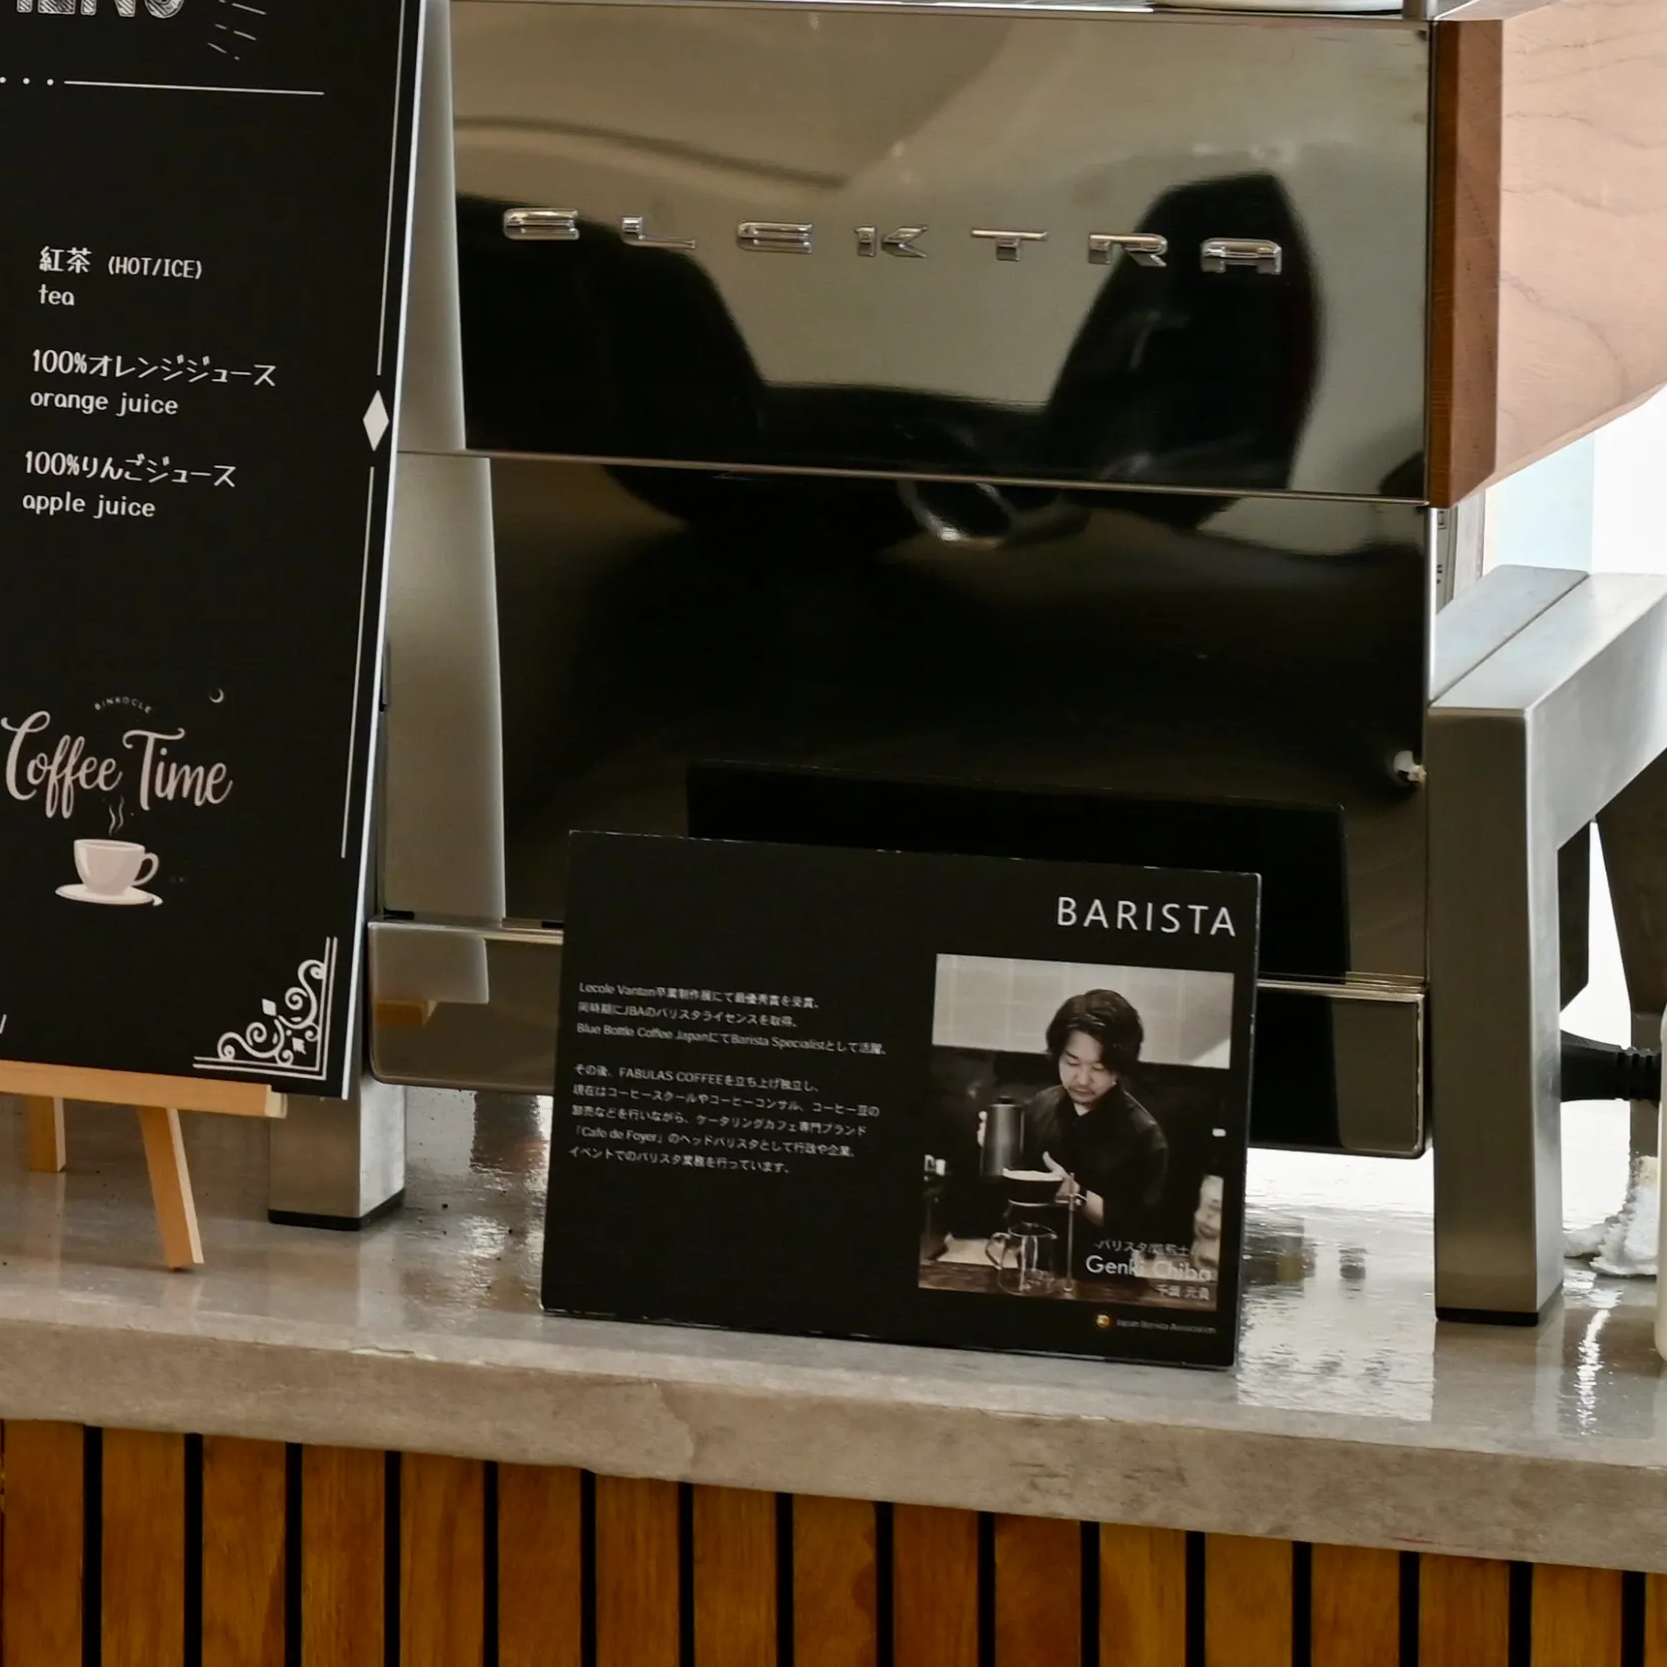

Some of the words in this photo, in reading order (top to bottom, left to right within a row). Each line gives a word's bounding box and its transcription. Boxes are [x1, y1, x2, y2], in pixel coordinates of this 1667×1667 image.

[502, 207, 1284, 275] ELEKTRA
[38, 245, 92, 274] 紅茶
[108, 255, 202, 280] (HOT/ICE)
[38, 283, 75, 306] tea
[32, 349, 276, 387] 100%オレンジジュース
[30, 392, 109, 415] orange
[115, 392, 179, 417] juice
[25, 450, 236, 488] 100%りんごジュース
[22, 491, 86, 516] apple
[93, 494, 156, 519] juice
[1, 710, 123, 819] Coffee
[122, 728, 233, 810] Time
[1057, 896, 1236, 937] BARISTA
[1086, 1255, 1144, 1276] Genki
